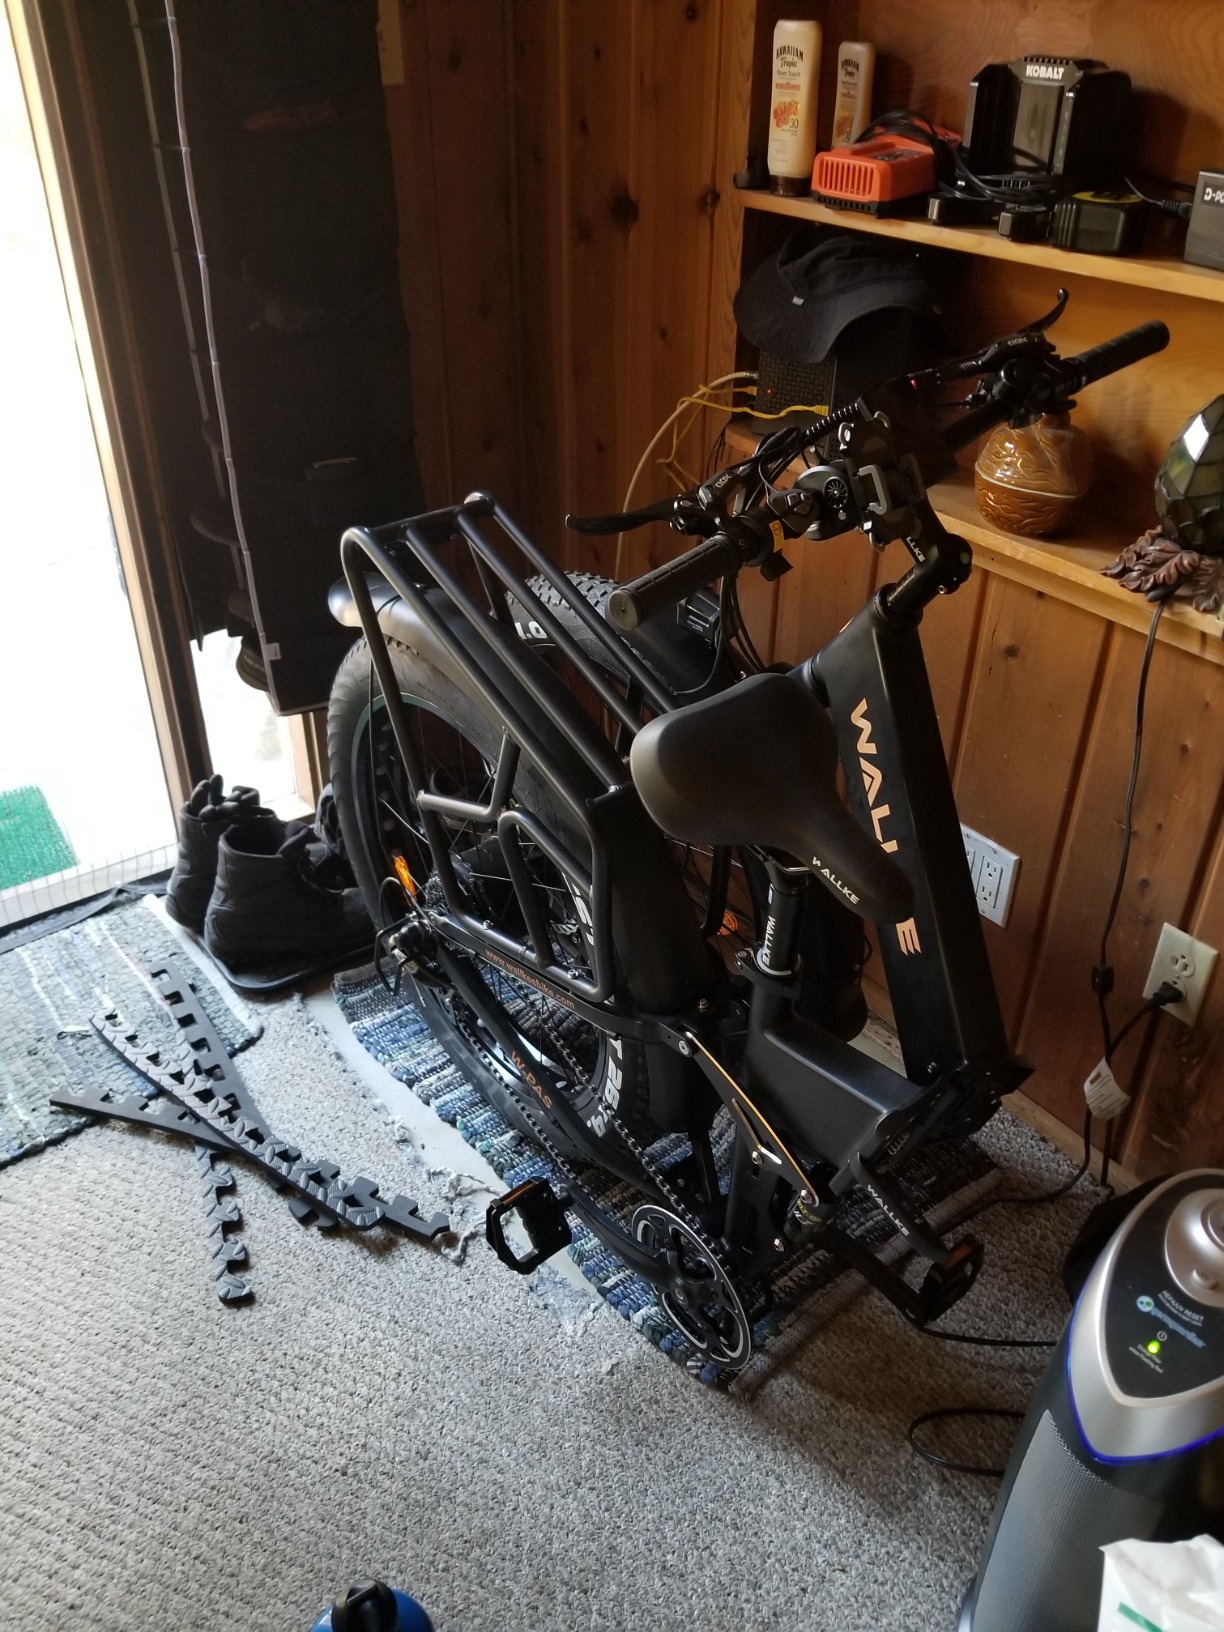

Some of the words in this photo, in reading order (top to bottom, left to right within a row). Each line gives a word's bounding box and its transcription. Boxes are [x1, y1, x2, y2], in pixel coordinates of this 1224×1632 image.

[776, 45, 804, 62] HAWAIIAN
[780, 57, 798, 69] Tropic
[1025, 64, 1065, 80] KOBALT
[789, 118, 799, 129] 30
[905, 535, 926, 562] LLKE
[812, 856, 860, 904] WALLKE
[762, 915, 776, 967] WALLKE
[511, 1051, 553, 1109] W-PAS
[867, 1184, 910, 1237] WALLKE
